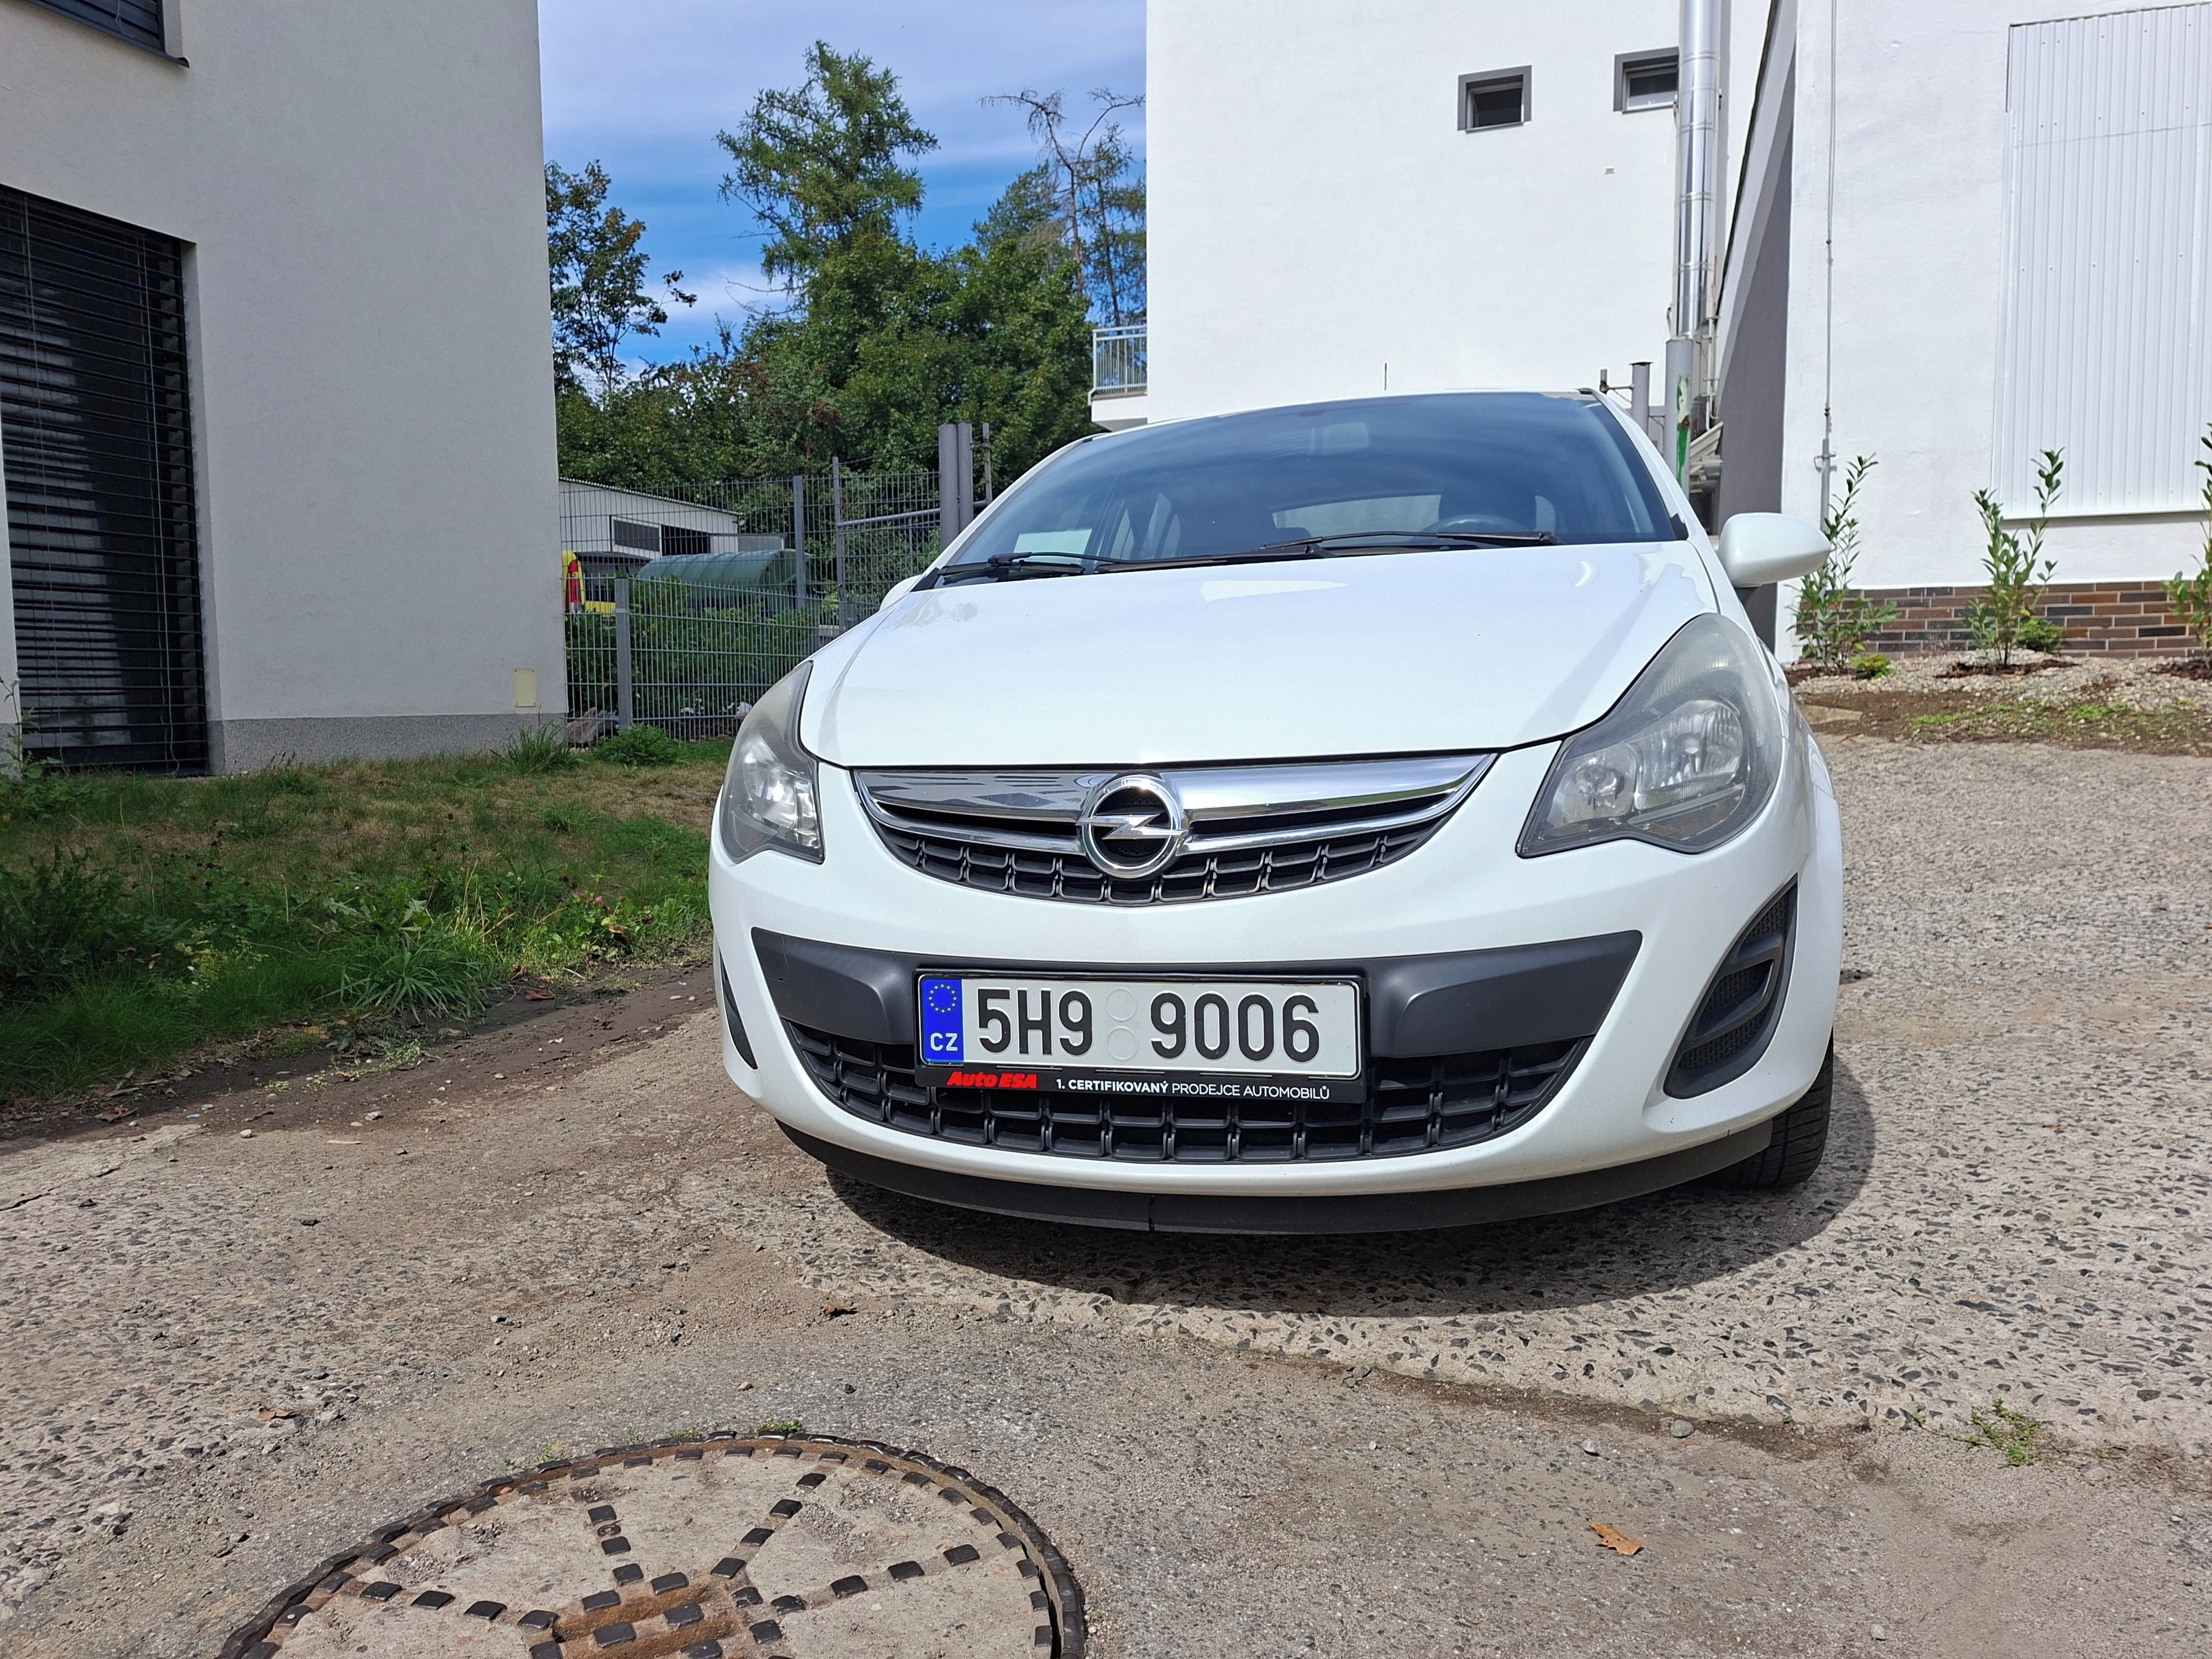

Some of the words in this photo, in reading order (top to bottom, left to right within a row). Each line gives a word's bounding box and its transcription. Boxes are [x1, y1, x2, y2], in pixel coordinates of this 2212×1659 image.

[977, 988, 1093, 1056] 5H9
[1150, 992, 1319, 1063] 9006
[930, 1032, 958, 1051] CZ
[946, 1071, 998, 1087] Auto
[998, 1073, 1038, 1089] ESA
[1056, 1078, 1066, 1089] 1.
[1068, 1079, 1169, 1094] CERTIFIKOVANÝ
[1172, 1083, 1240, 1096] PRODEJCE
[1243, 1085, 1330, 1100] AUTOMOBILŮ
